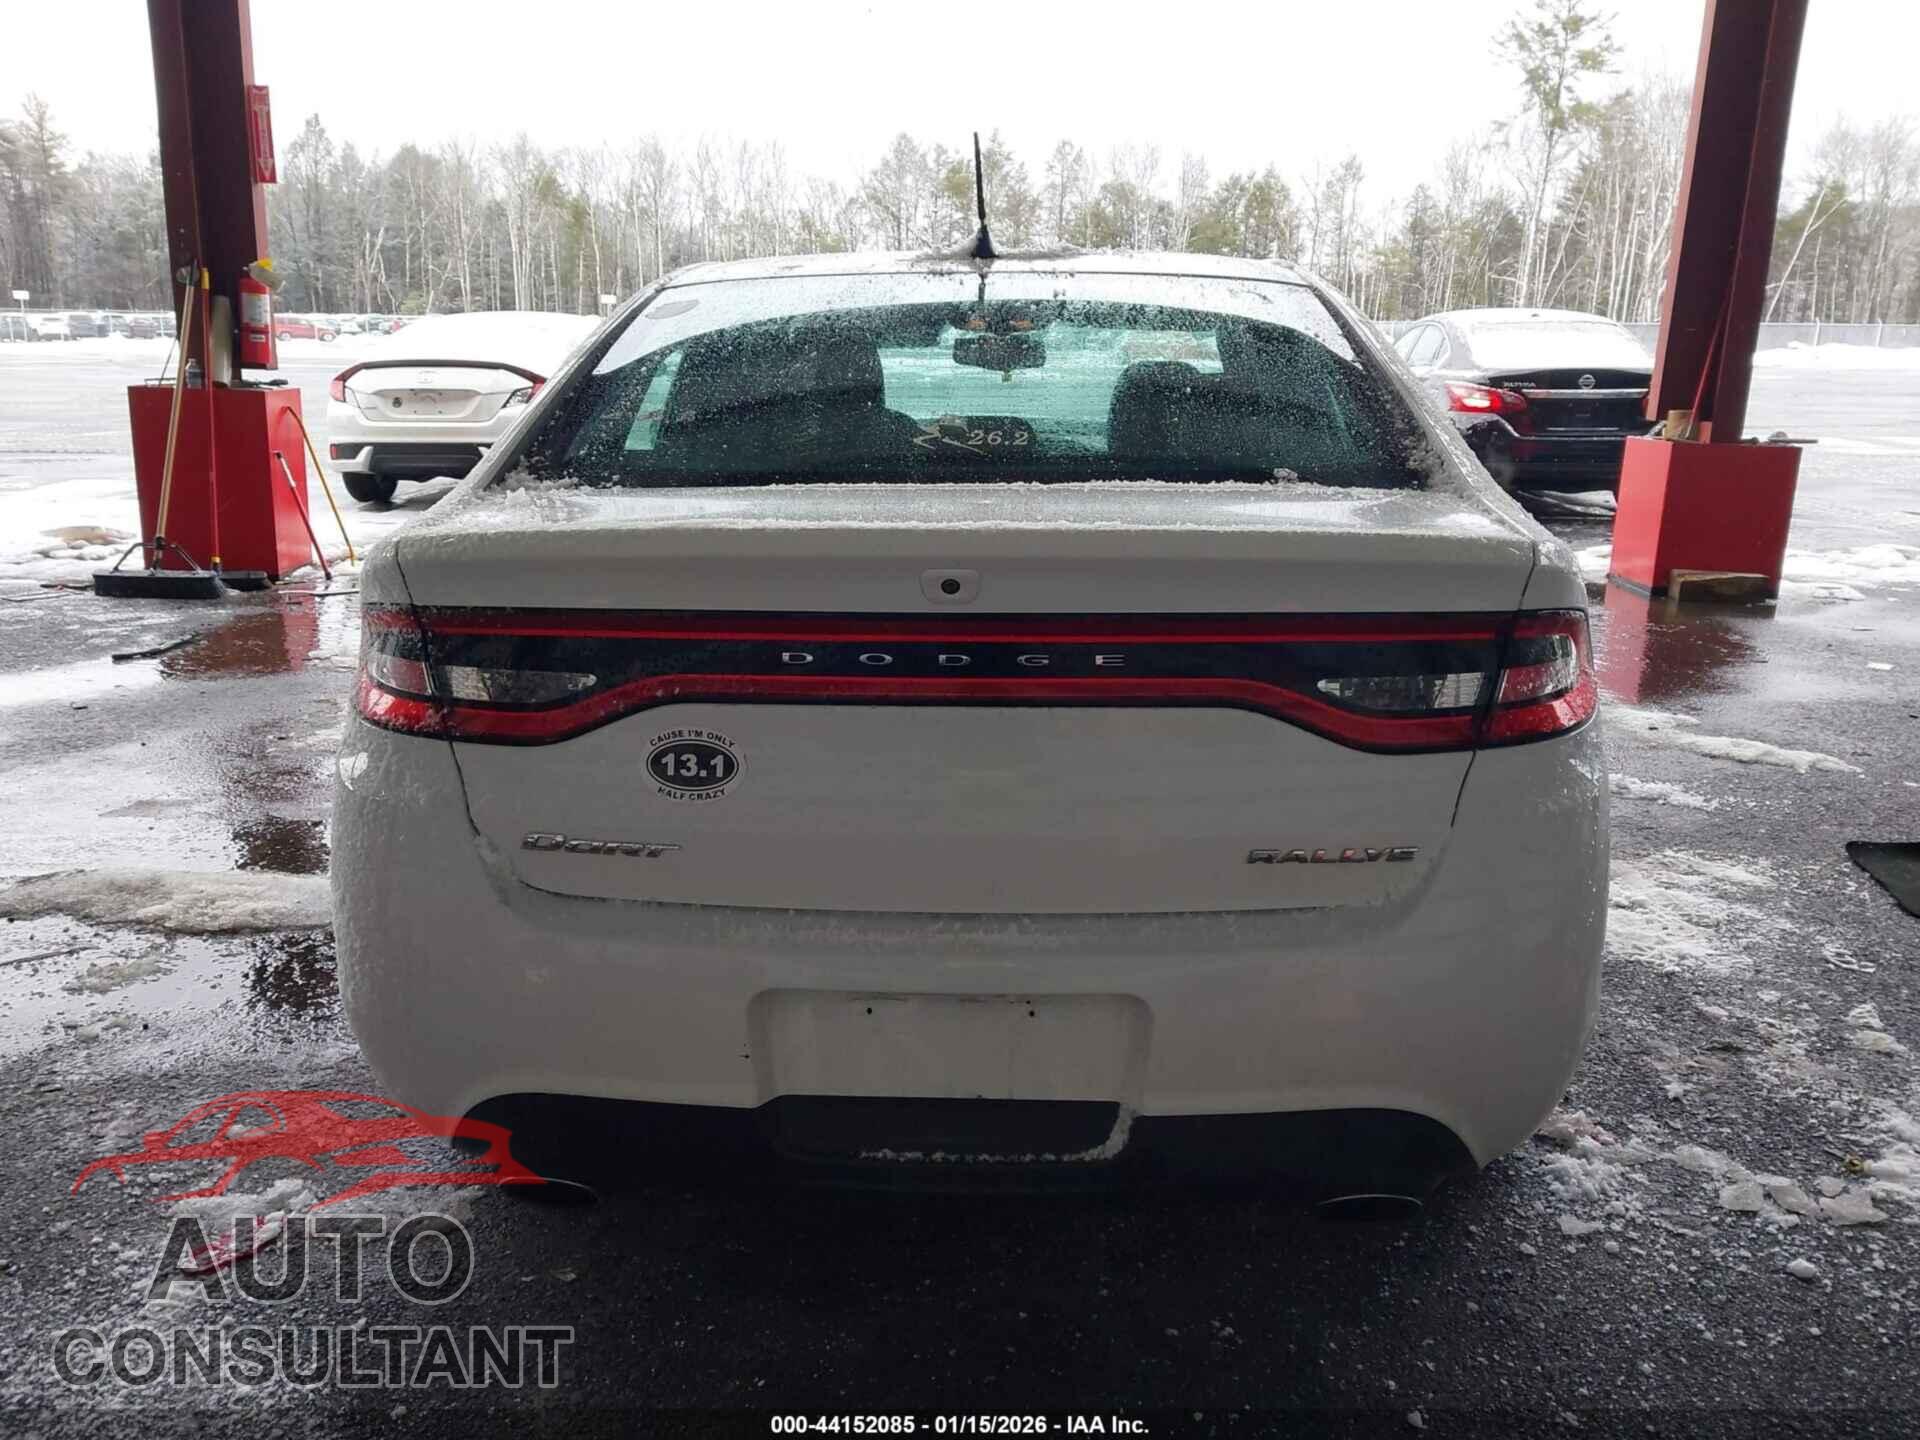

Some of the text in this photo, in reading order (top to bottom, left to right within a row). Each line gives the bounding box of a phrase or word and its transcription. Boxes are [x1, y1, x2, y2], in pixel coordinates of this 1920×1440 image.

[967, 430, 1029, 446] 26.2
[782, 652, 1126, 667] DODGE
[649, 729, 736, 749] CAUSE I'M ONLY
[661, 753, 725, 778] 13.1
[688, 787, 727, 801] CRAZY
[1247, 846, 1419, 864] RALLYE
